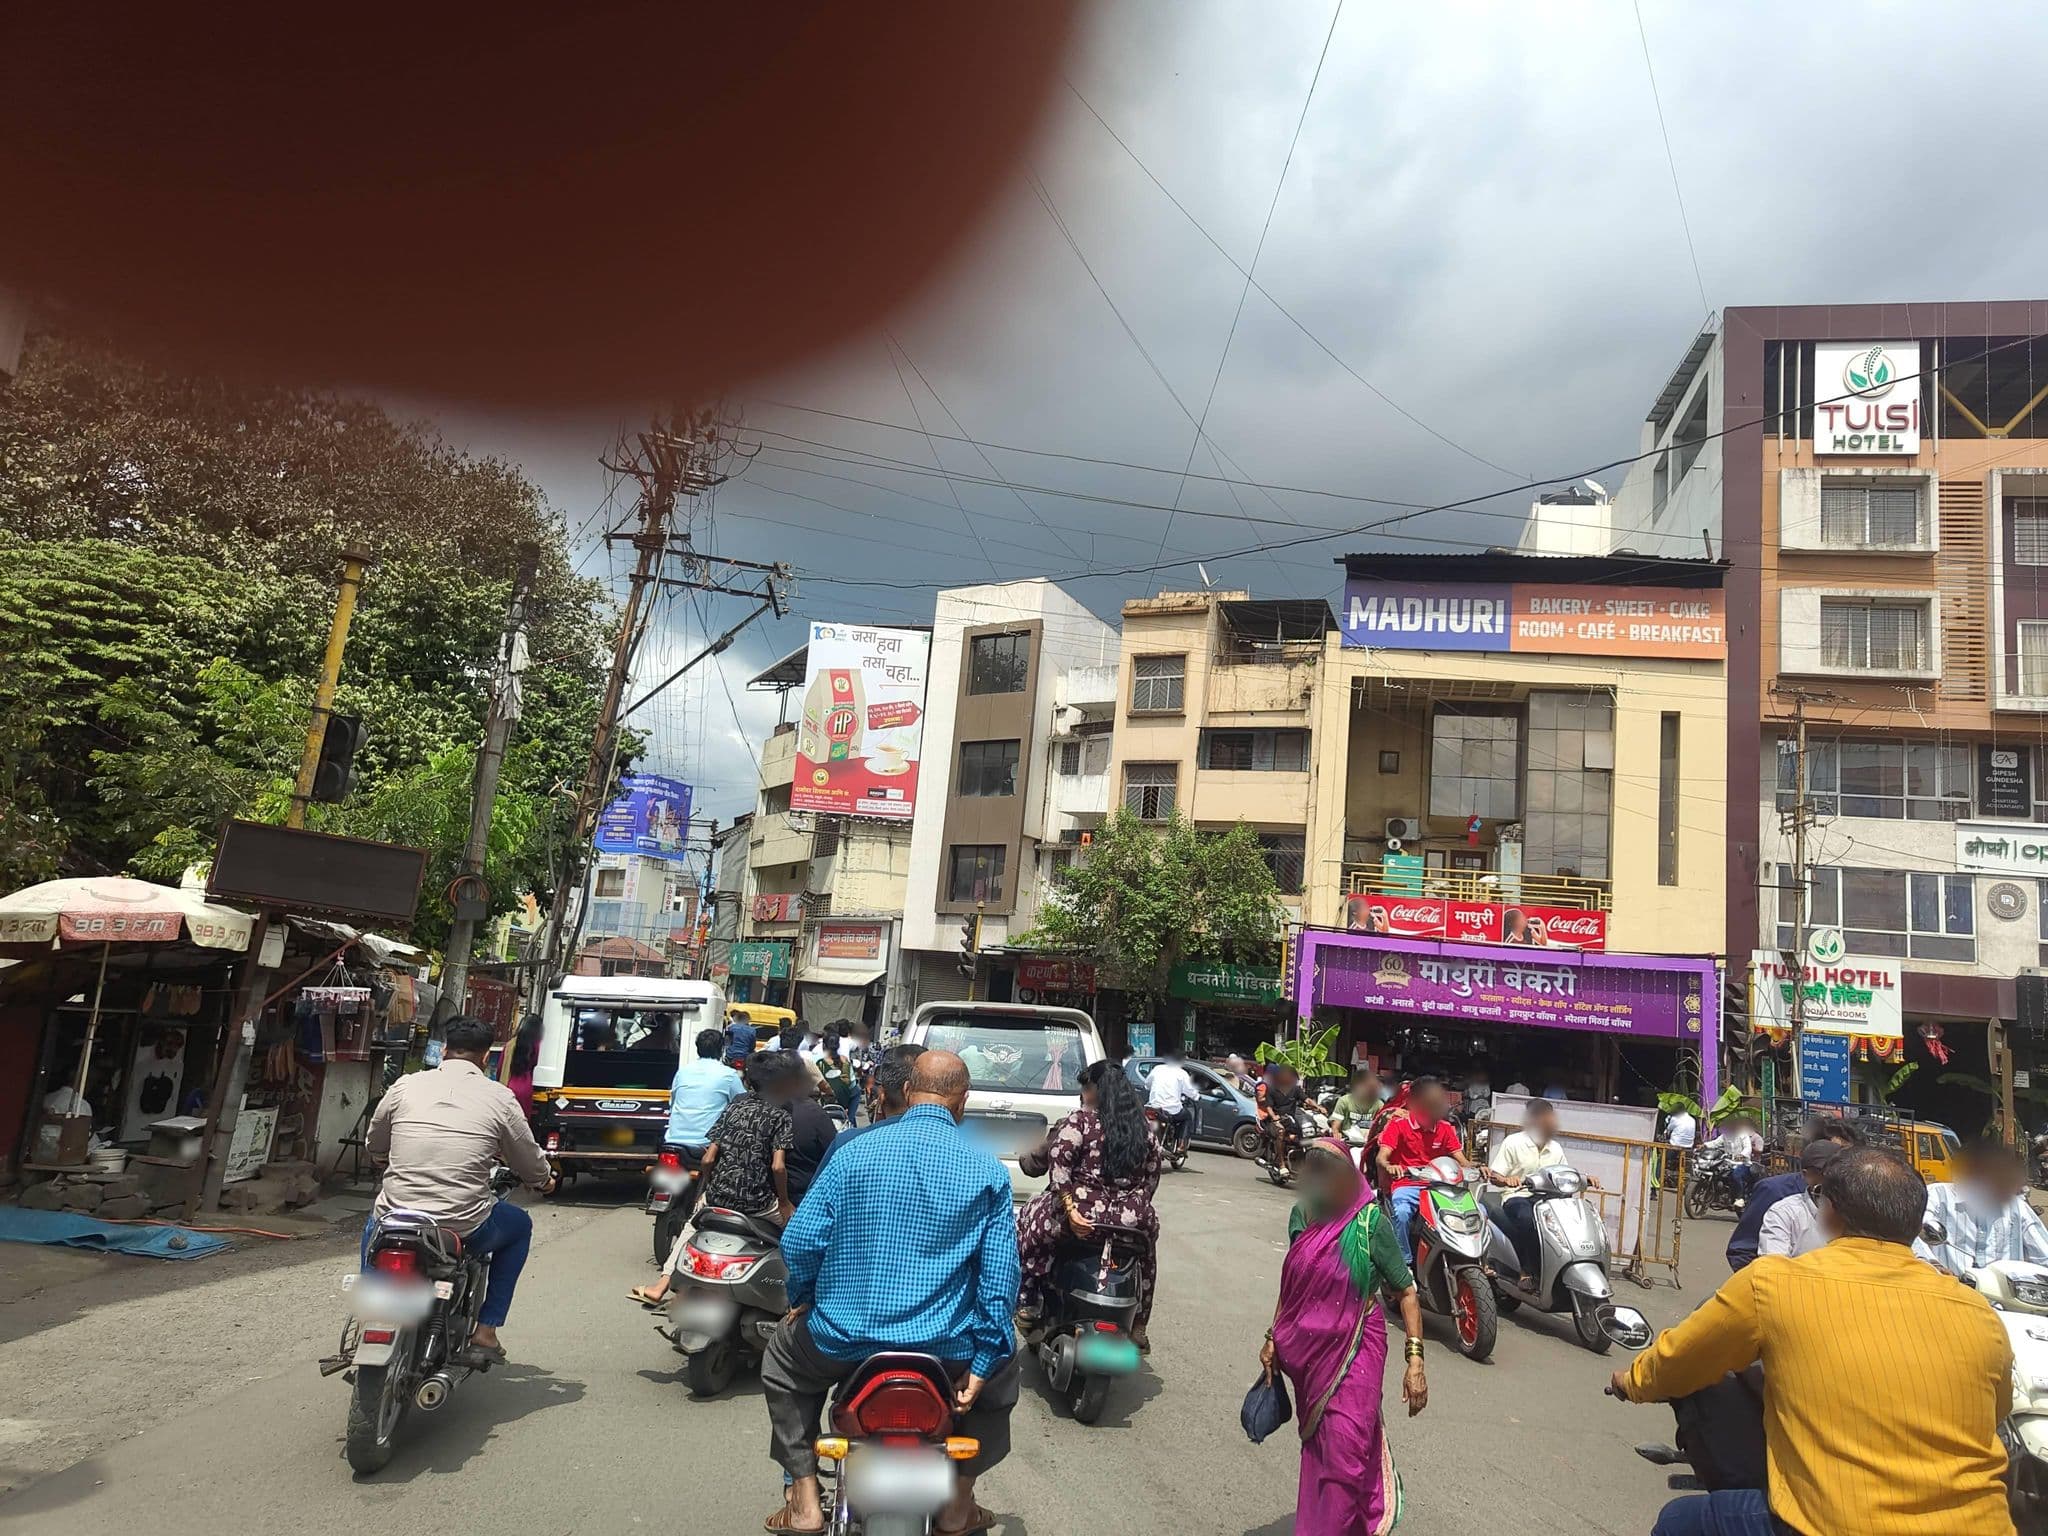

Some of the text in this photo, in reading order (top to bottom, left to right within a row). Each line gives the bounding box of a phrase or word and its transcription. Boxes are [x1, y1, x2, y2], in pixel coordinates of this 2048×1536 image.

[1818, 399, 1919, 433] TULSI
[1832, 434, 1904, 451] HOTEL
[1348, 594, 1505, 636] MADHURI
[1530, 597, 1711, 621] BAKERY SWEET CAKE
[851, 629, 877, 645] जसा
[1518, 619, 1722, 645] ROOM CAFÉ BREAKFAST
[876, 637, 903, 655] हवा
[862, 655, 886, 670] तसा
[834, 711, 853, 735] HP
[1985, 776, 2024, 784] GUNDESHA
[1390, 904, 1441, 924] Coca-Cola
[1454, 908, 1495, 929] माधुरी
[194, 923, 226, 940] 98.3
[1546, 915, 1601, 936] Coca-Cola
[1384, 958, 1401, 970] 60
[1418, 959, 1577, 998] माधुरी बेकरी
[1824, 967, 1895, 989] HOTEL
[1829, 983, 1874, 1009] हॉटेल
[1837, 1010, 1868, 1019] ROOMS
